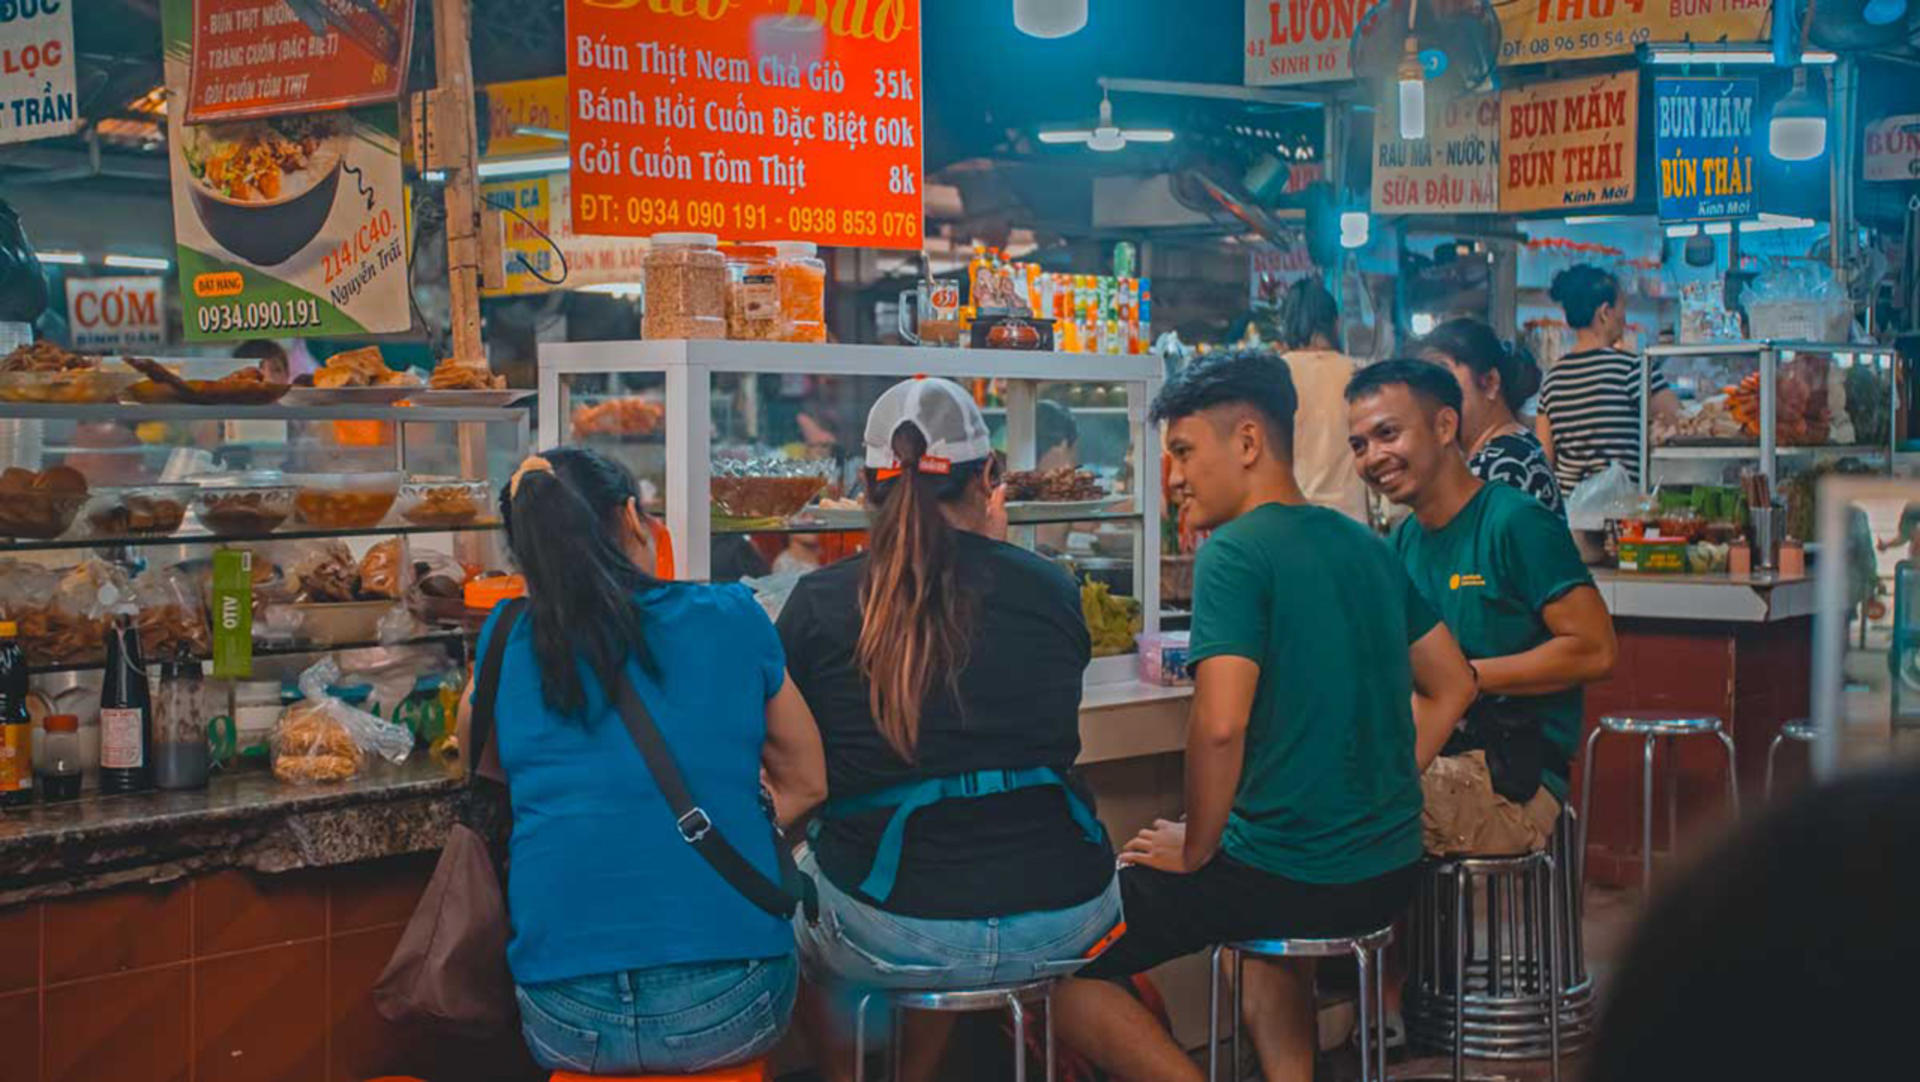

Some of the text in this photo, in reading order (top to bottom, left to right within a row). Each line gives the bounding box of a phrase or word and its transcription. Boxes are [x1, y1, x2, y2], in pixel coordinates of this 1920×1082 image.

[4, 40, 62, 78] LỌC
[1530, 38, 1549, 54] 08
[1554, 36, 1574, 51] 96
[1580, 32, 1599, 48] 50
[1605, 28, 1623, 46] 54
[577, 34, 913, 100] Bún Thịt Nem Chả Giò 35k
[1270, 54, 1309, 77] SINH
[11, 81, 72, 127] TRẦN
[578, 87, 914, 150] Bánh Hỏi Cuốn Đặc Biệt 60k
[1509, 92, 1558, 139] BÚN
[1563, 80, 1626, 133] MẮM
[1660, 82, 1752, 138] BÚN MẮM
[579, 136, 915, 195] Gỏi Cuốn Tôm Thịt 8k
[1508, 132, 1623, 189] BÚN THÁI
[1661, 143, 1753, 198] BÚN THÁI
[1425, 173, 1464, 209] ĐẬU
[580, 194, 618, 222] ĐT:
[627, 196, 679, 225] 0934
[687, 200, 725, 228] 090
[733, 202, 766, 230] 191
[789, 207, 836, 233] 0938
[843, 210, 876, 235] 853
[882, 211, 916, 238] 076
[75, 286, 157, 328] CƠM
[331, 260, 376, 308] Nguyễn
[199, 299, 321, 333] 0934.090.191
